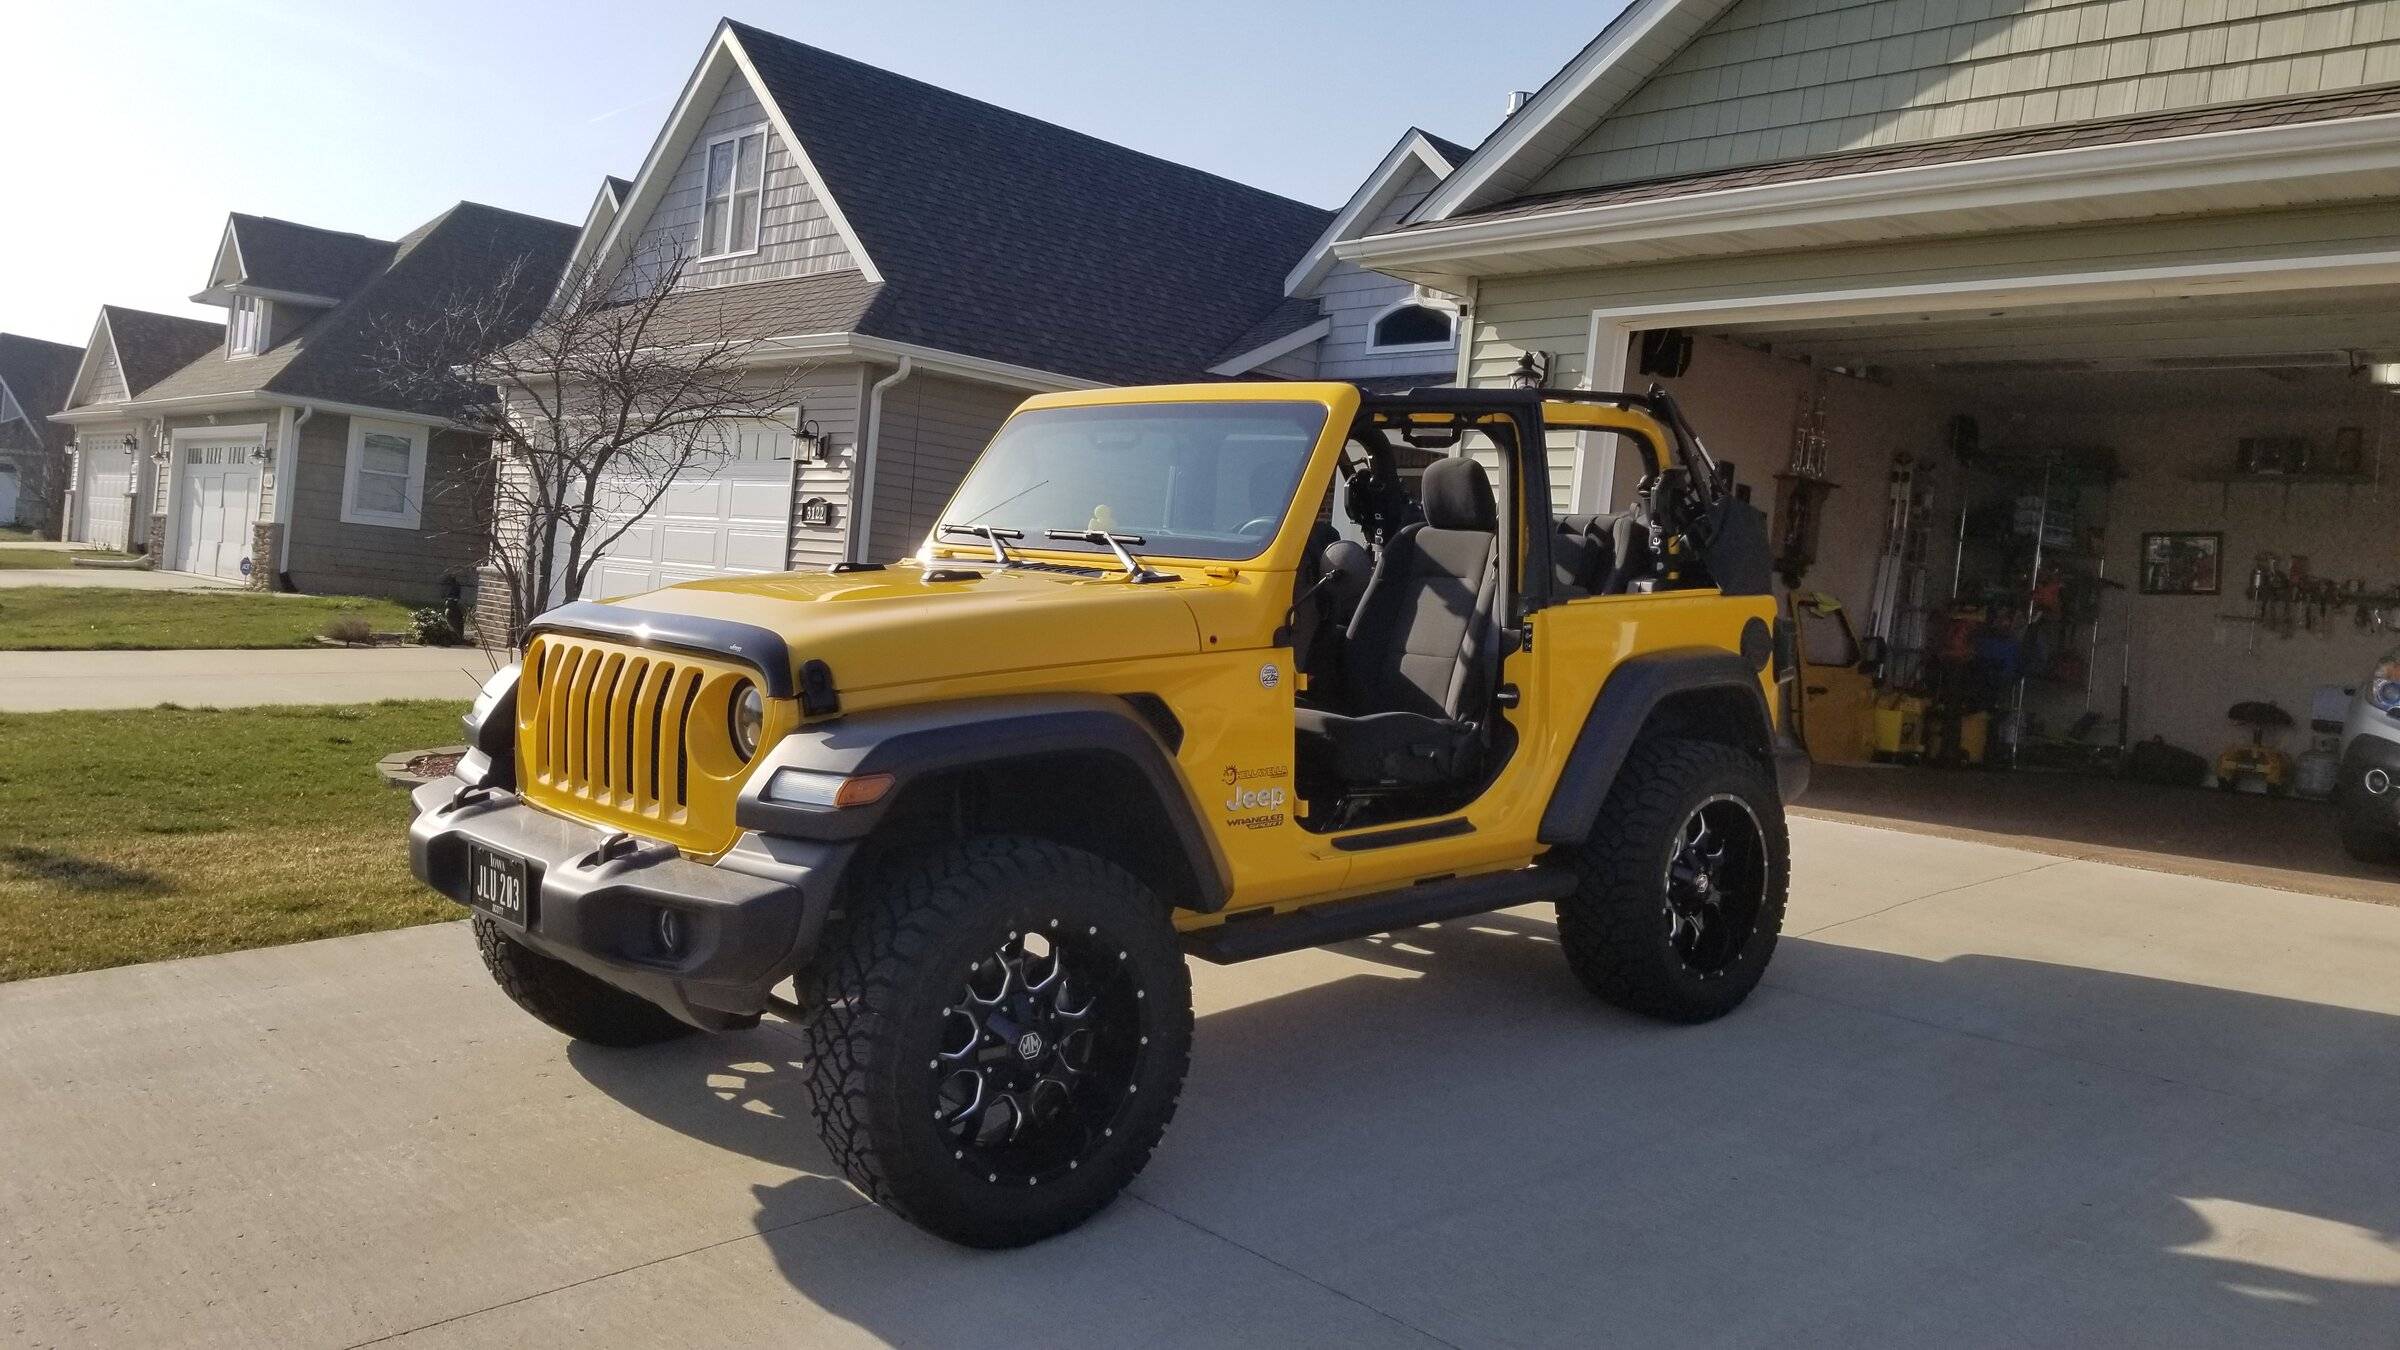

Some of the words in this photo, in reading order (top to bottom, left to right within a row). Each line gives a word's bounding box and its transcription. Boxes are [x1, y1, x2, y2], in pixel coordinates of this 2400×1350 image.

[807, 506, 824, 520] 3122
[1374, 513, 1384, 544] Jep
[1226, 785, 1285, 811] Jeep
[1227, 814, 1284, 826] WRANGLER
[477, 865, 496, 902] JLU
[500, 873, 519, 911] 203
